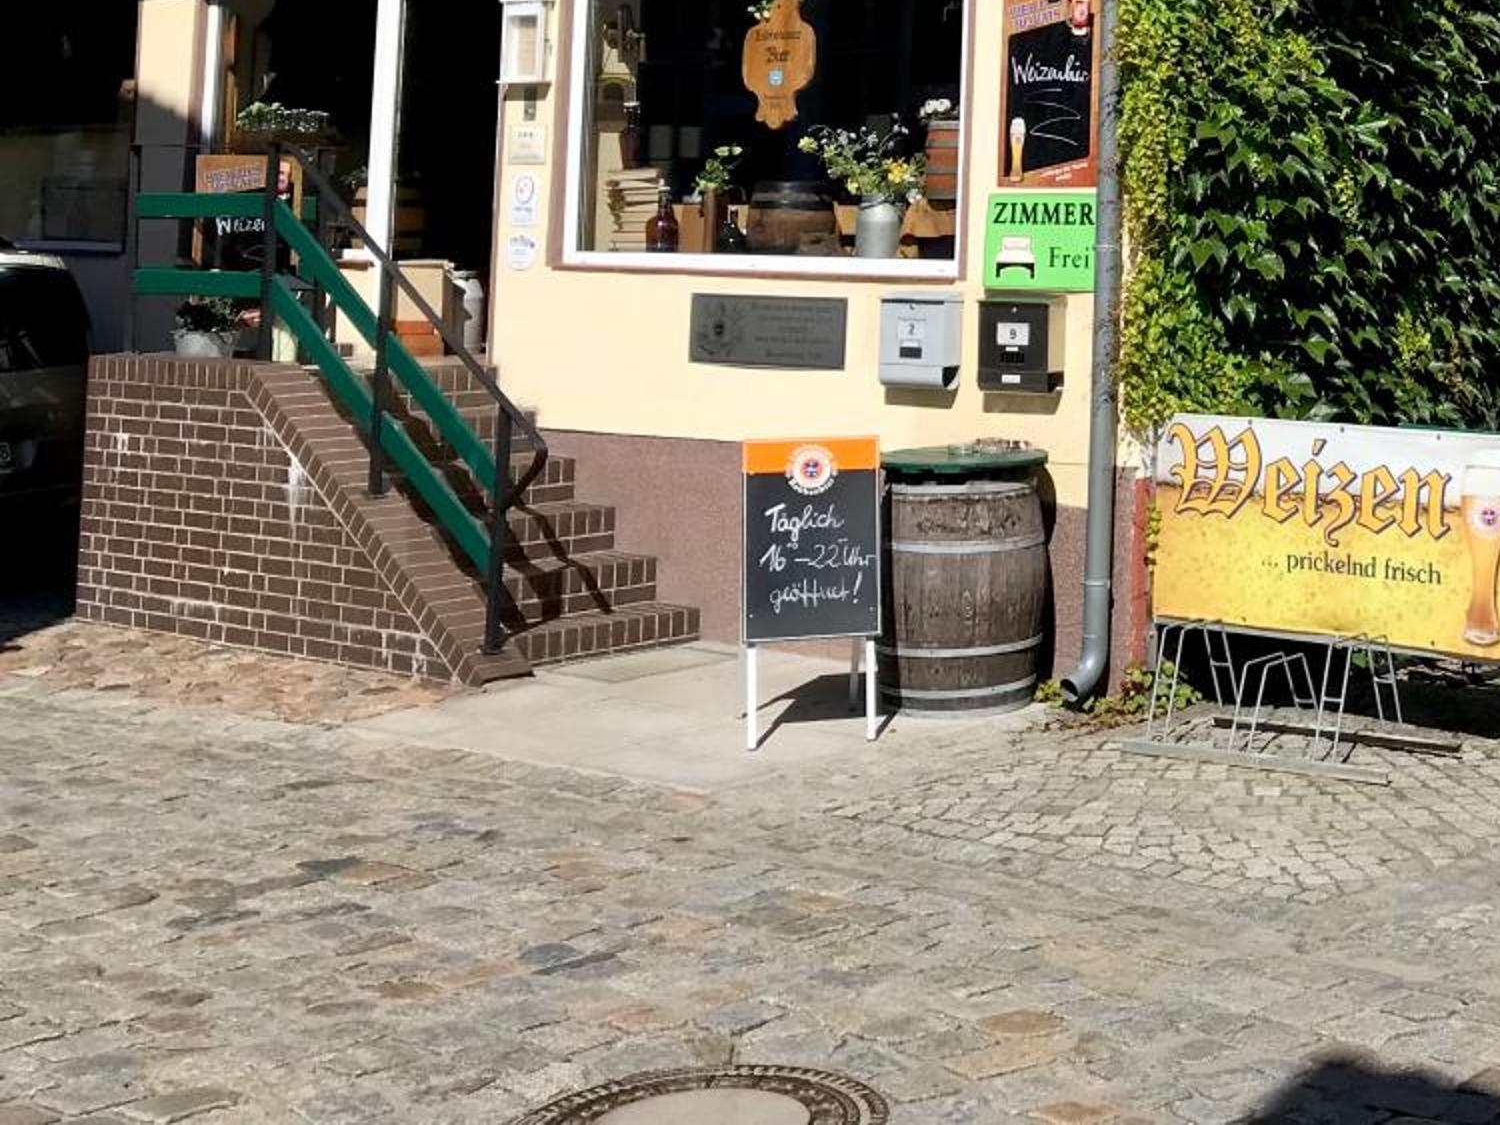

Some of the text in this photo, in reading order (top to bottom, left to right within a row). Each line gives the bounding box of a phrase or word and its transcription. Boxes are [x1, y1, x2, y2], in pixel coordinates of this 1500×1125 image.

[993, 202, 1095, 226] ZIMMER
[1049, 246, 1089, 269] Frei
[1166, 422, 1453, 547] Weizen
[764, 503, 845, 542] Täglich
[1286, 551, 1377, 578] prickelnd
[1384, 557, 1442, 585] frisch
